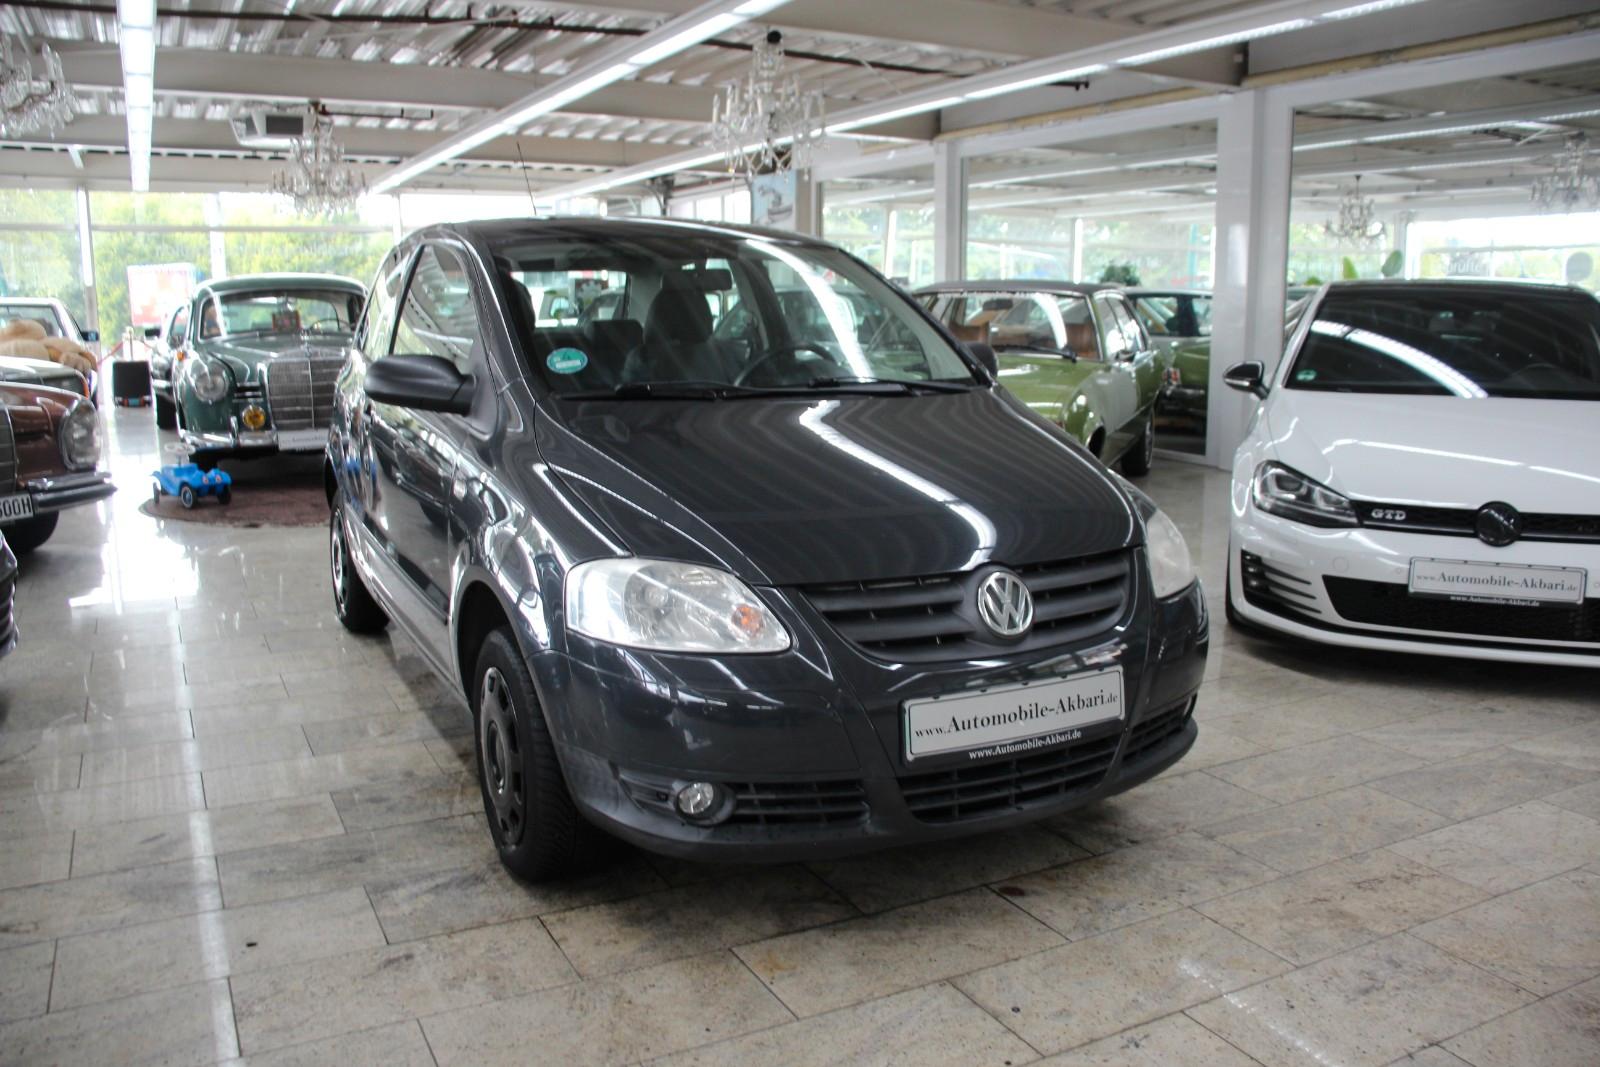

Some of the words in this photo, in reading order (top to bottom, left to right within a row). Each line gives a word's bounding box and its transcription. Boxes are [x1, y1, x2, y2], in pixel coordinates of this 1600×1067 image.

[0, 497, 32, 518] 00H
[1371, 509, 1406, 521] GTD
[1416, 571, 1578, 592] www.Automobile-Akbari.de
[915, 690, 1118, 737] www.Automobile-Akbari.de
[969, 730, 1082, 760] www.Automobile-Akbari.de
